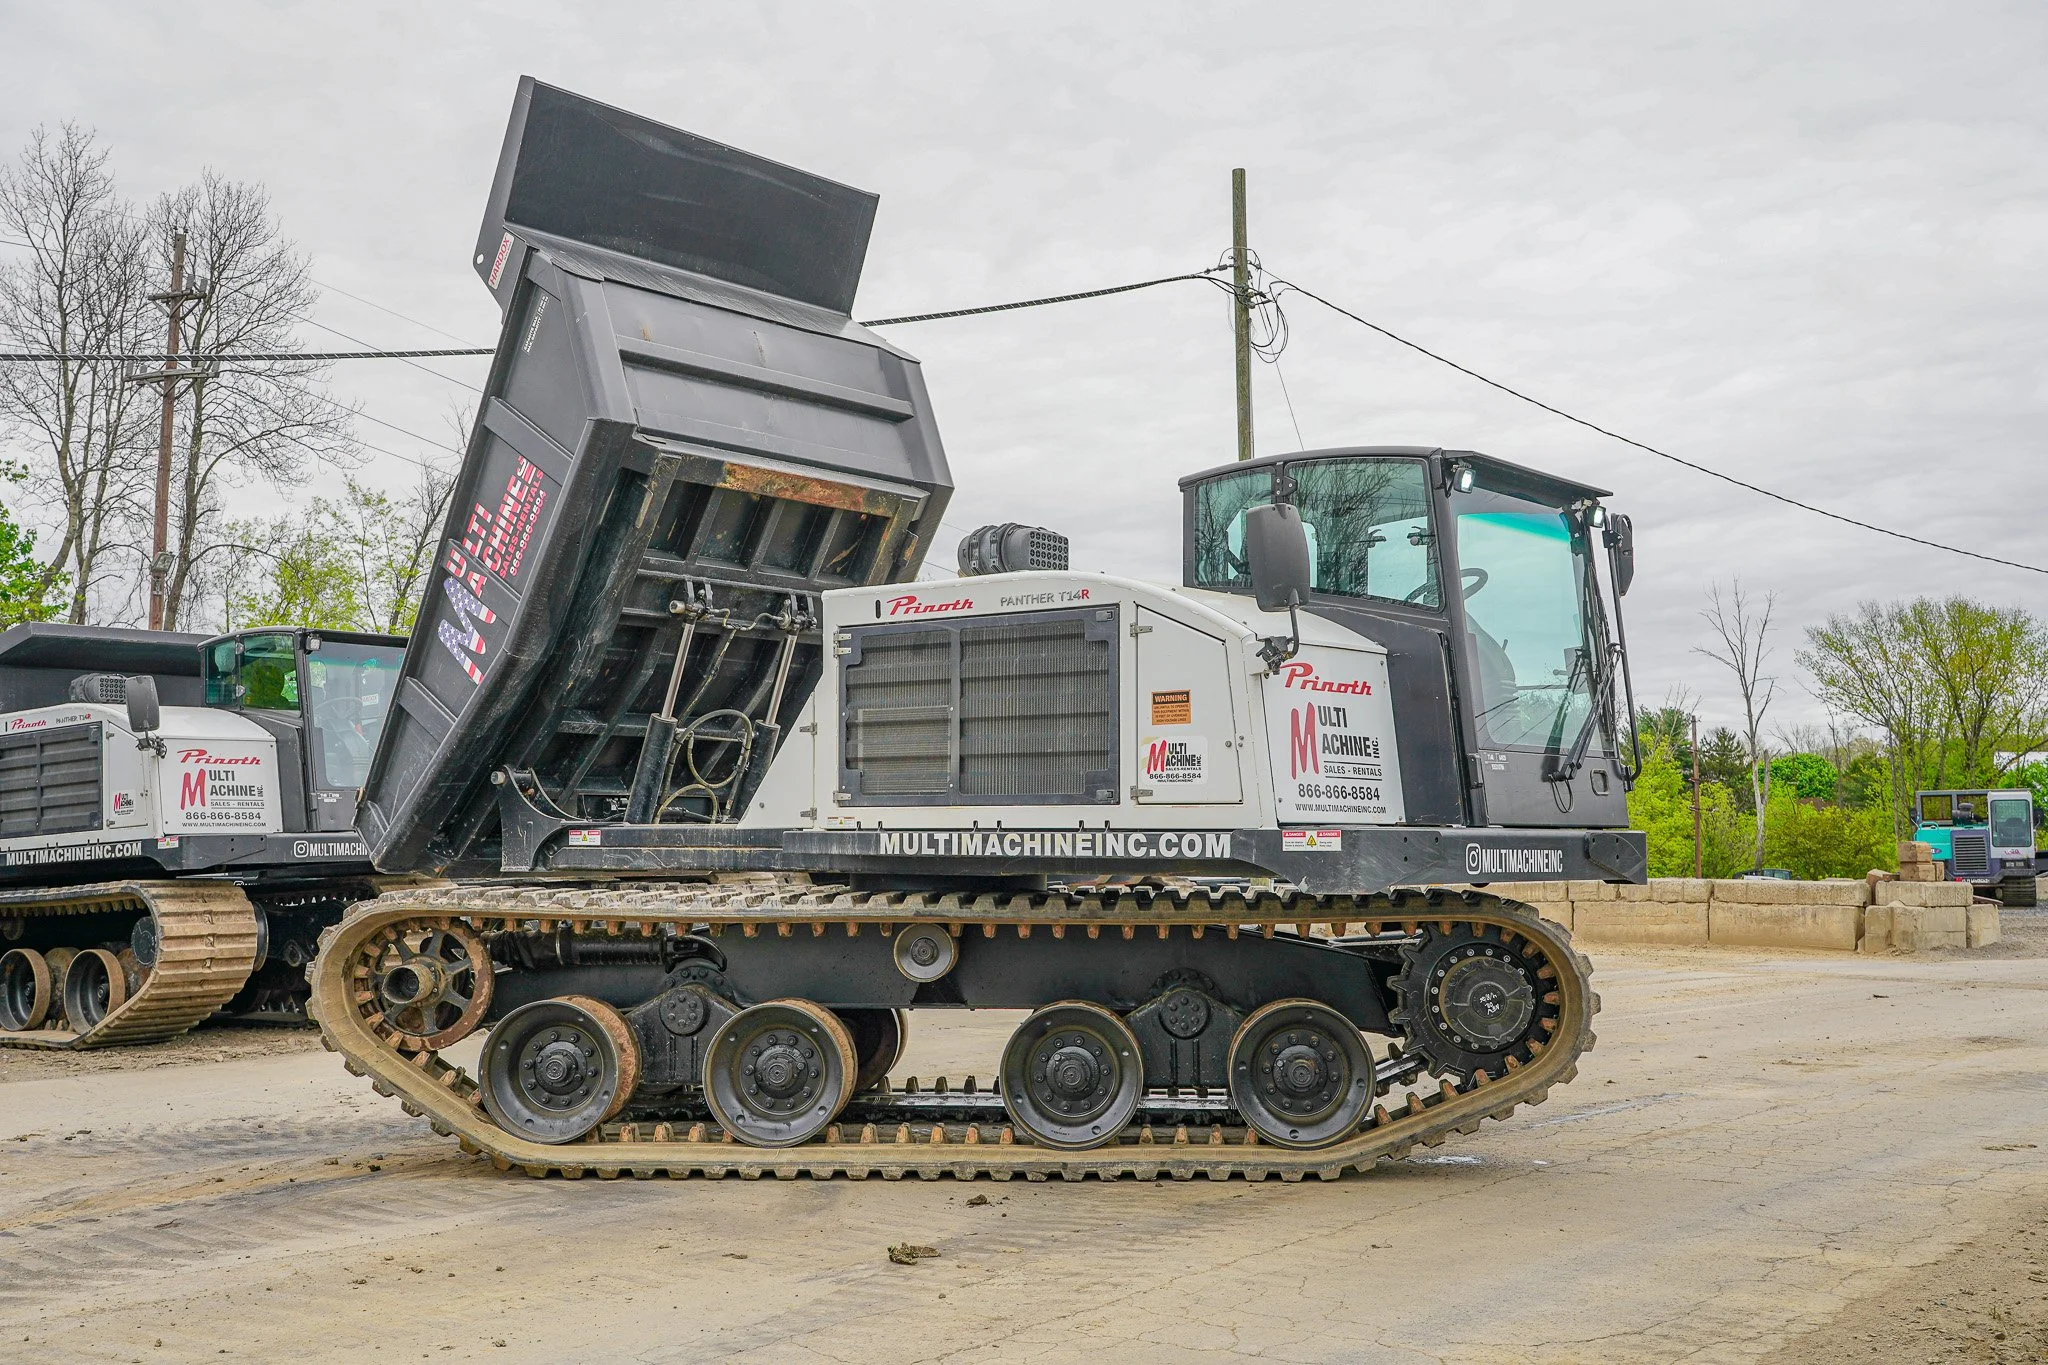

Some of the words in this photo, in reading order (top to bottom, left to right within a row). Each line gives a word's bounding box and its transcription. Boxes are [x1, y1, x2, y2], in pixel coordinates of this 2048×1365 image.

[490, 236, 510, 285] HARDOX
[500, 470, 544, 579] SALES-RENTALS
[886, 595, 973, 615] Prinoth
[1000, 592, 1055, 607] PANTHER
[1058, 589, 1089, 602] T14R
[1279, 663, 1371, 695] Prinoth
[1154, 694, 1188, 703] WARNING
[11, 718, 47, 730] Prinoth
[177, 749, 261, 765] Prinoth
[1324, 765, 1346, 774] SALES
[1353, 767, 1382, 776] RENTALS
[1298, 783, 1380, 801] 866-866-8584
[185, 812, 261, 820] 866-866-8584
[1295, 803, 1386, 814] WWW.MULTIMACHINEINC.COM
[6, 841, 142, 866] MULTIMACHINEINC.COM
[878, 833, 1231, 858] MULTIMACHINEINC.COM
[1482, 849, 1563, 873] MULTIMACHINEINC
